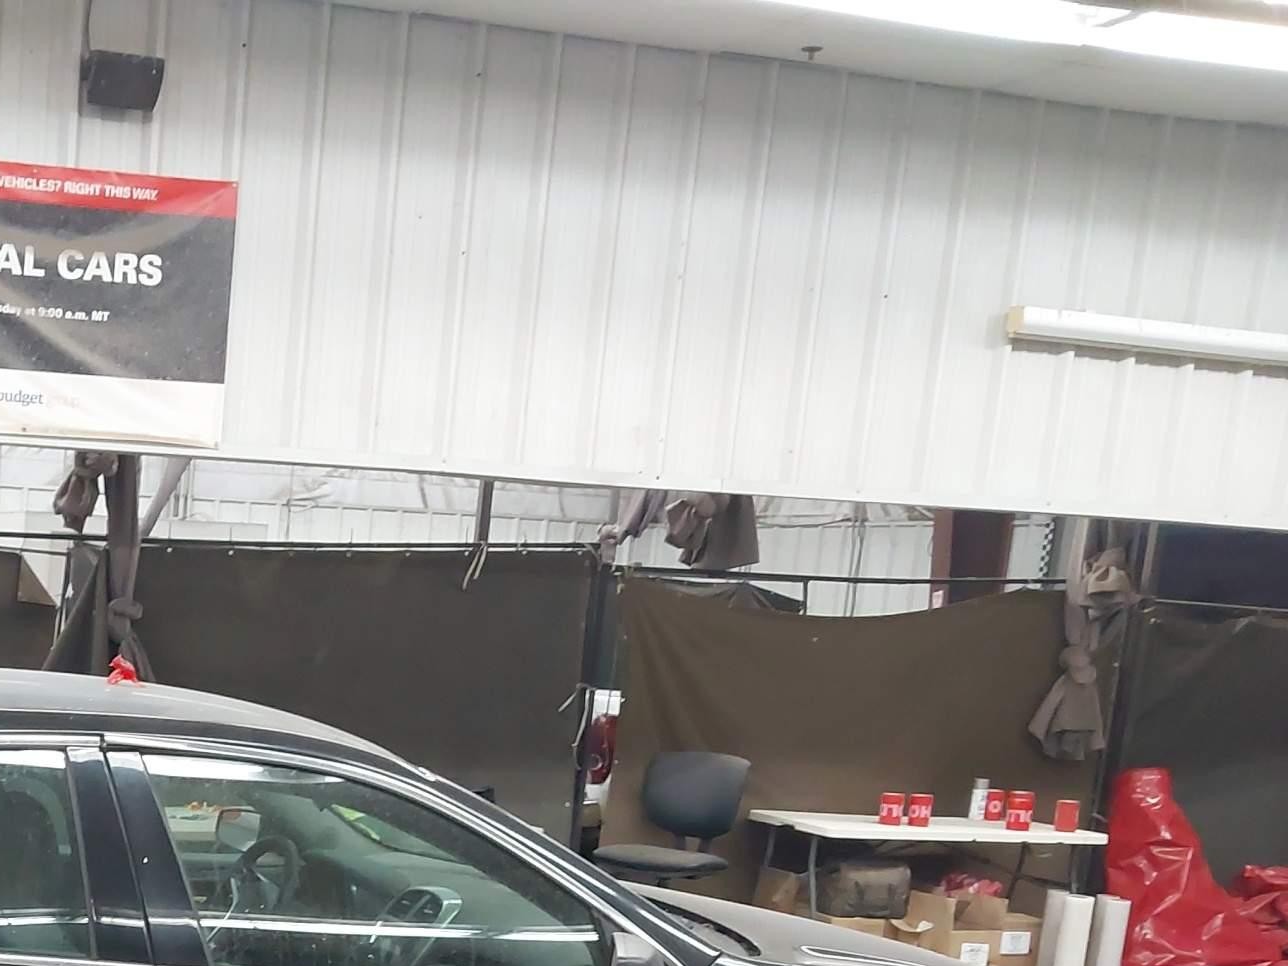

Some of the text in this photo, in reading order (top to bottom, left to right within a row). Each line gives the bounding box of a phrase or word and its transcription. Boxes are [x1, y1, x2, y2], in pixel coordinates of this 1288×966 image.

[63, 180, 102, 196] RIGHT
[103, 184, 131, 199] THIS
[57, 249, 163, 287] CARS
[23, 306, 36, 316] at
[37, 306, 64, 319] 9:00
[64, 309, 89, 320] a.m.
[90, 310, 111, 322] MT
